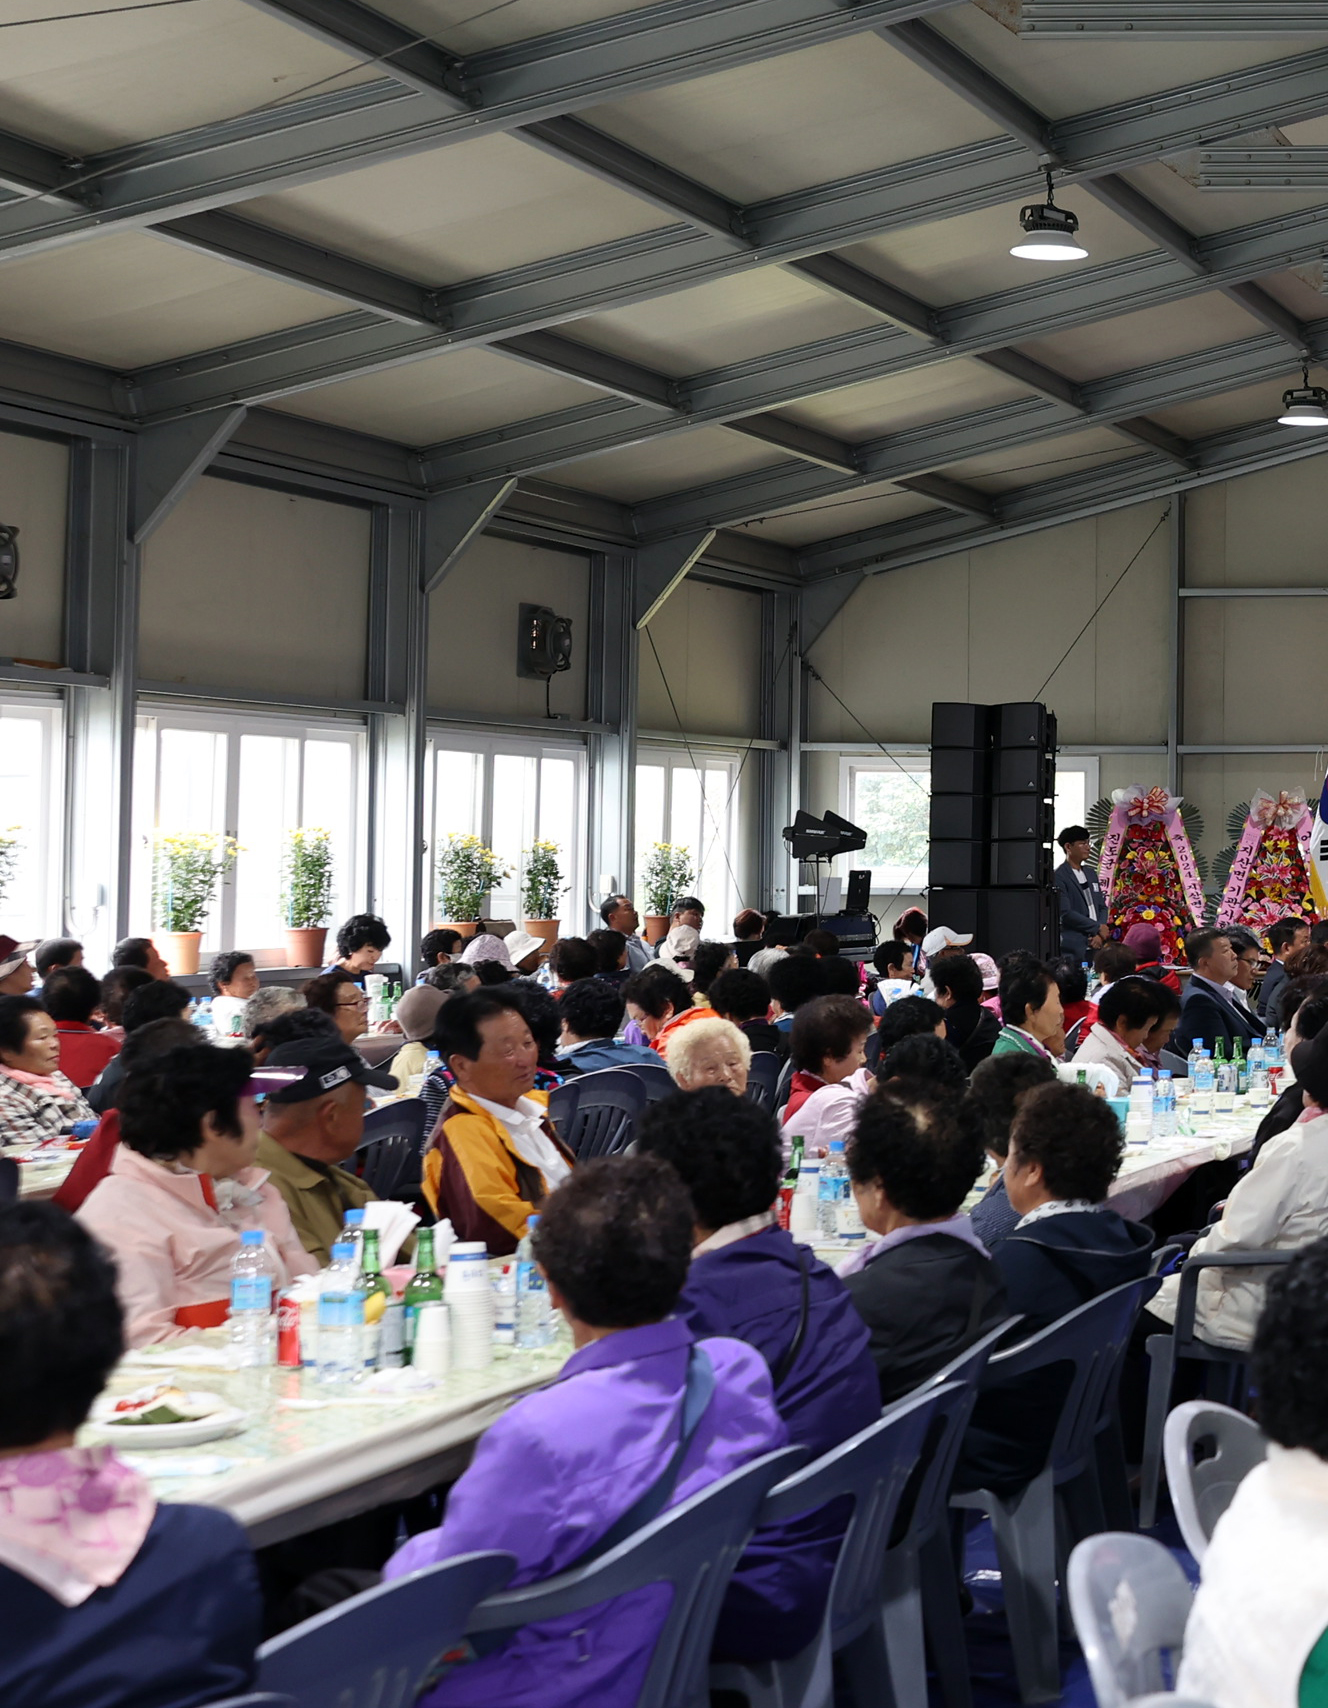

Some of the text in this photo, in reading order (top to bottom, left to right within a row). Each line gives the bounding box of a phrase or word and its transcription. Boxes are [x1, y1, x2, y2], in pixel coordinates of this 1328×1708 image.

[1102, 833, 1121, 870] 진도군
[1233, 845, 1254, 882] 지산면
[1177, 846, 1194, 879] 2024
[1187, 883, 1203, 908] 지산면
